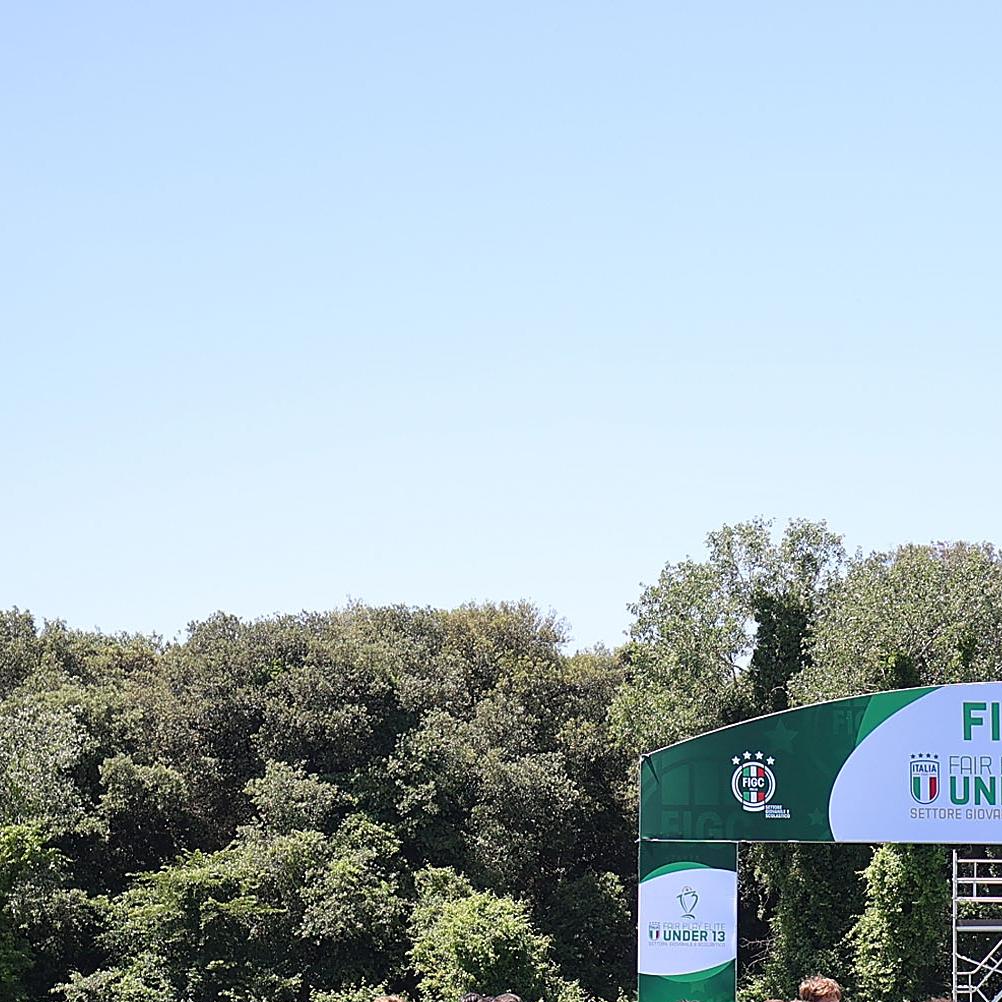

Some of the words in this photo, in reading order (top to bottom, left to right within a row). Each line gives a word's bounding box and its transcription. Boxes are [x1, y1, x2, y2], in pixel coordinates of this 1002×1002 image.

[912, 764, 937, 773] ITALIA
[949, 755, 992, 775] FAIR
[742, 777, 765, 788] FIGC
[910, 807, 962, 820] SETTORE
[663, 929, 708, 942] UNDER
[711, 930, 726, 942] 13
